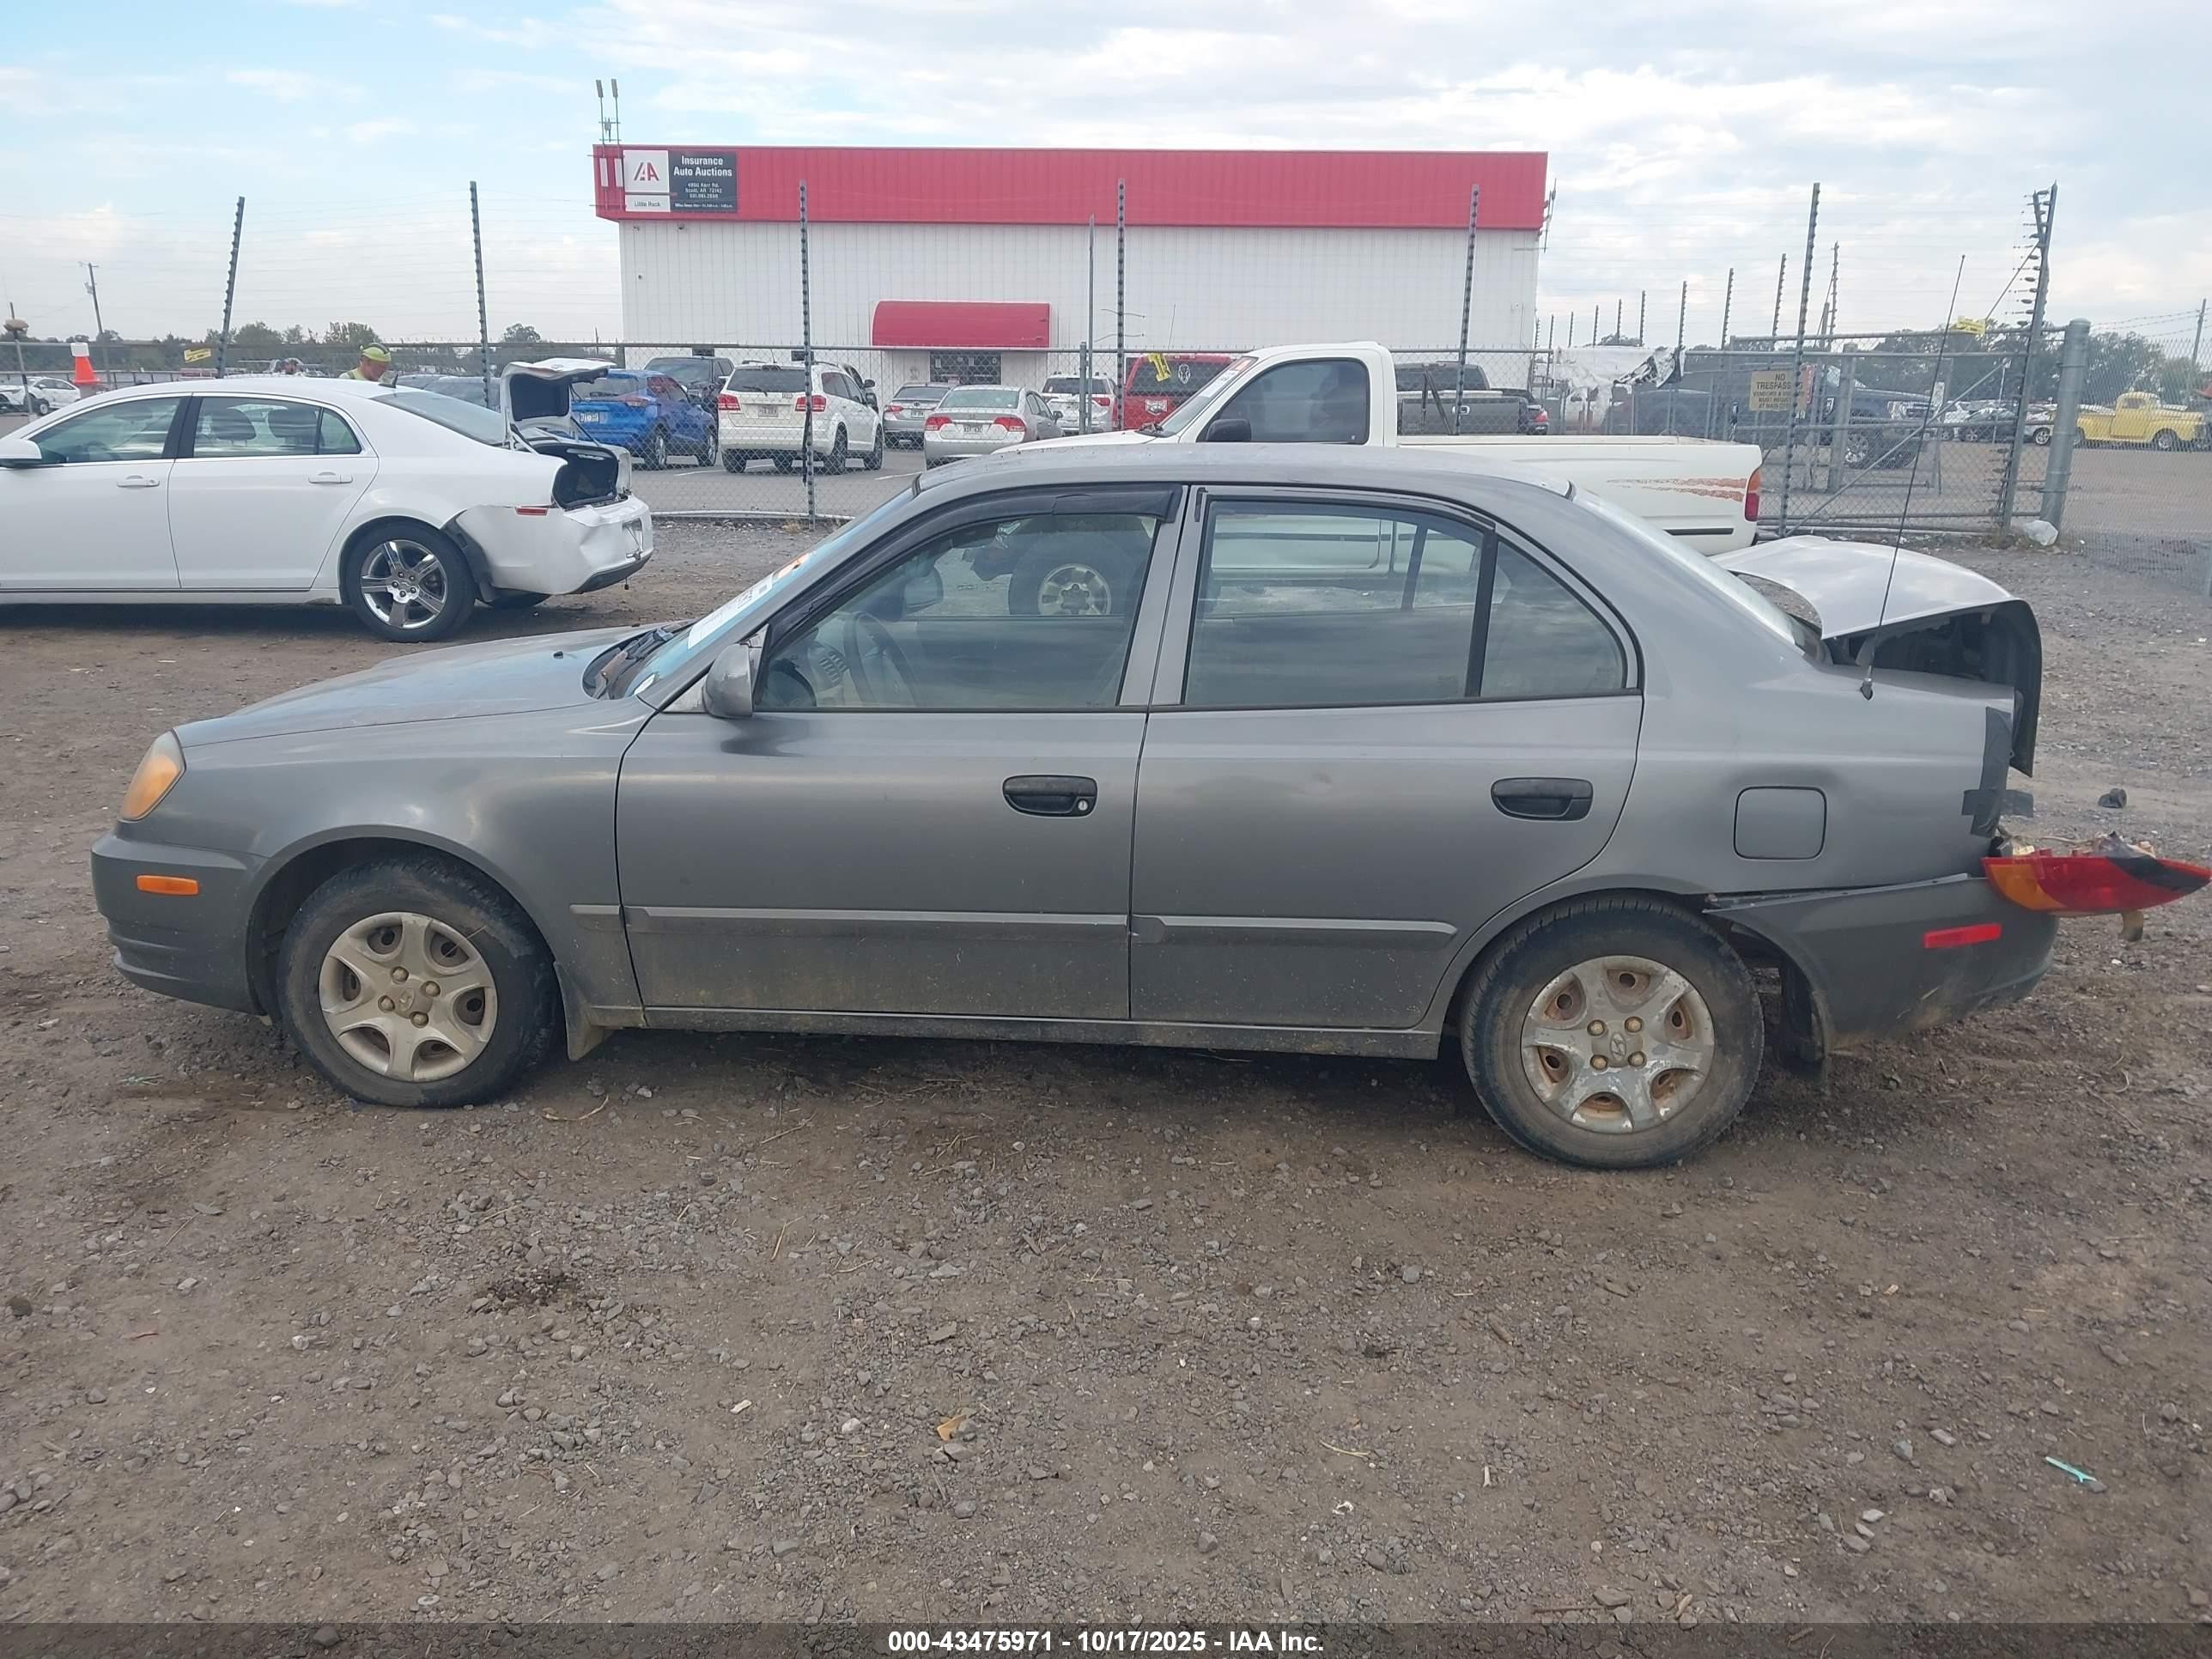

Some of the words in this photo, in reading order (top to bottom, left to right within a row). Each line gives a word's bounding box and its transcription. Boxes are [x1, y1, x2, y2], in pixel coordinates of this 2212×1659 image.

[681, 155, 723, 166] Insurance
[673, 166, 693, 176] Auto
[695, 167, 732, 177] Auctions
